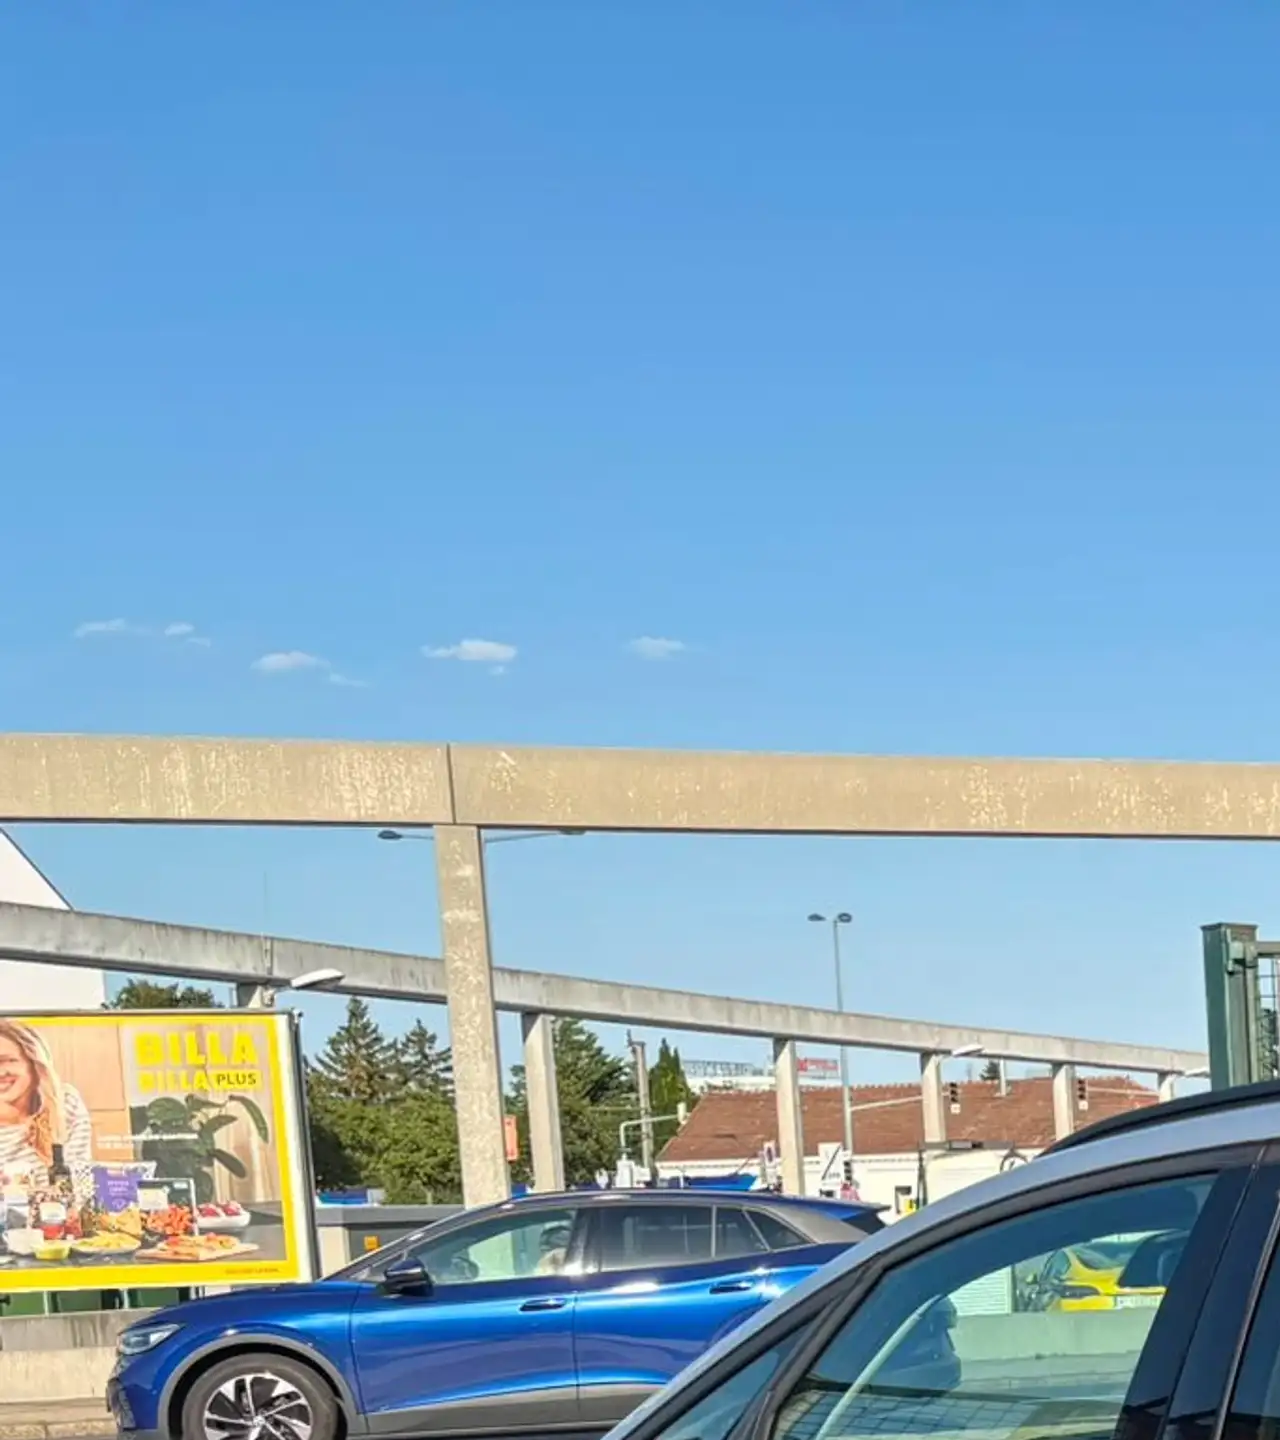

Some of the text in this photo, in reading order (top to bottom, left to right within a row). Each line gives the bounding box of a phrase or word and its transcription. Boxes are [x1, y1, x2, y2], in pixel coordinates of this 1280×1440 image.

[137, 1032, 257, 1065] BILLA
[139, 1070, 257, 1092] BILLA PLUS
